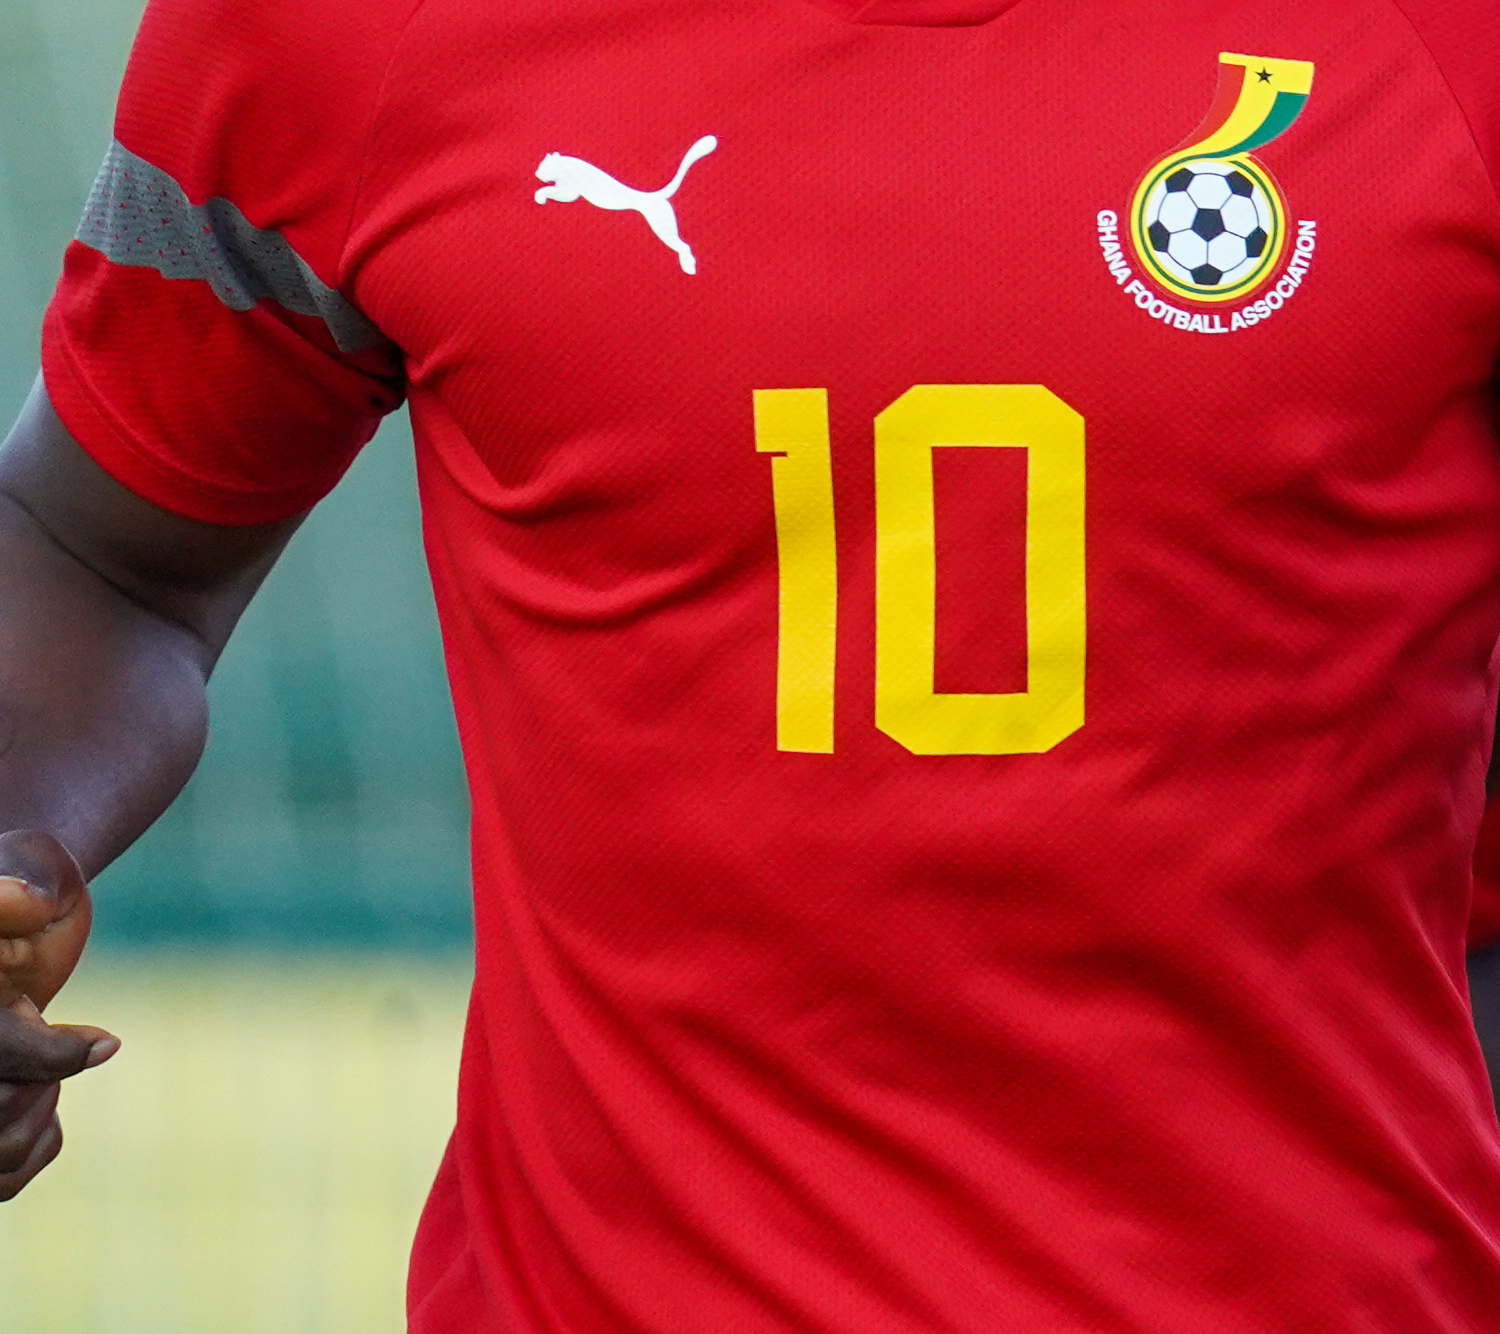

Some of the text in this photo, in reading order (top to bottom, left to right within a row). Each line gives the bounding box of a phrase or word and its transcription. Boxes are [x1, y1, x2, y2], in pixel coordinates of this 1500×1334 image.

[1096, 208, 1317, 334] GHANA FOOTBALL ASSOCIATION
[753, 384, 1087, 756] 10
